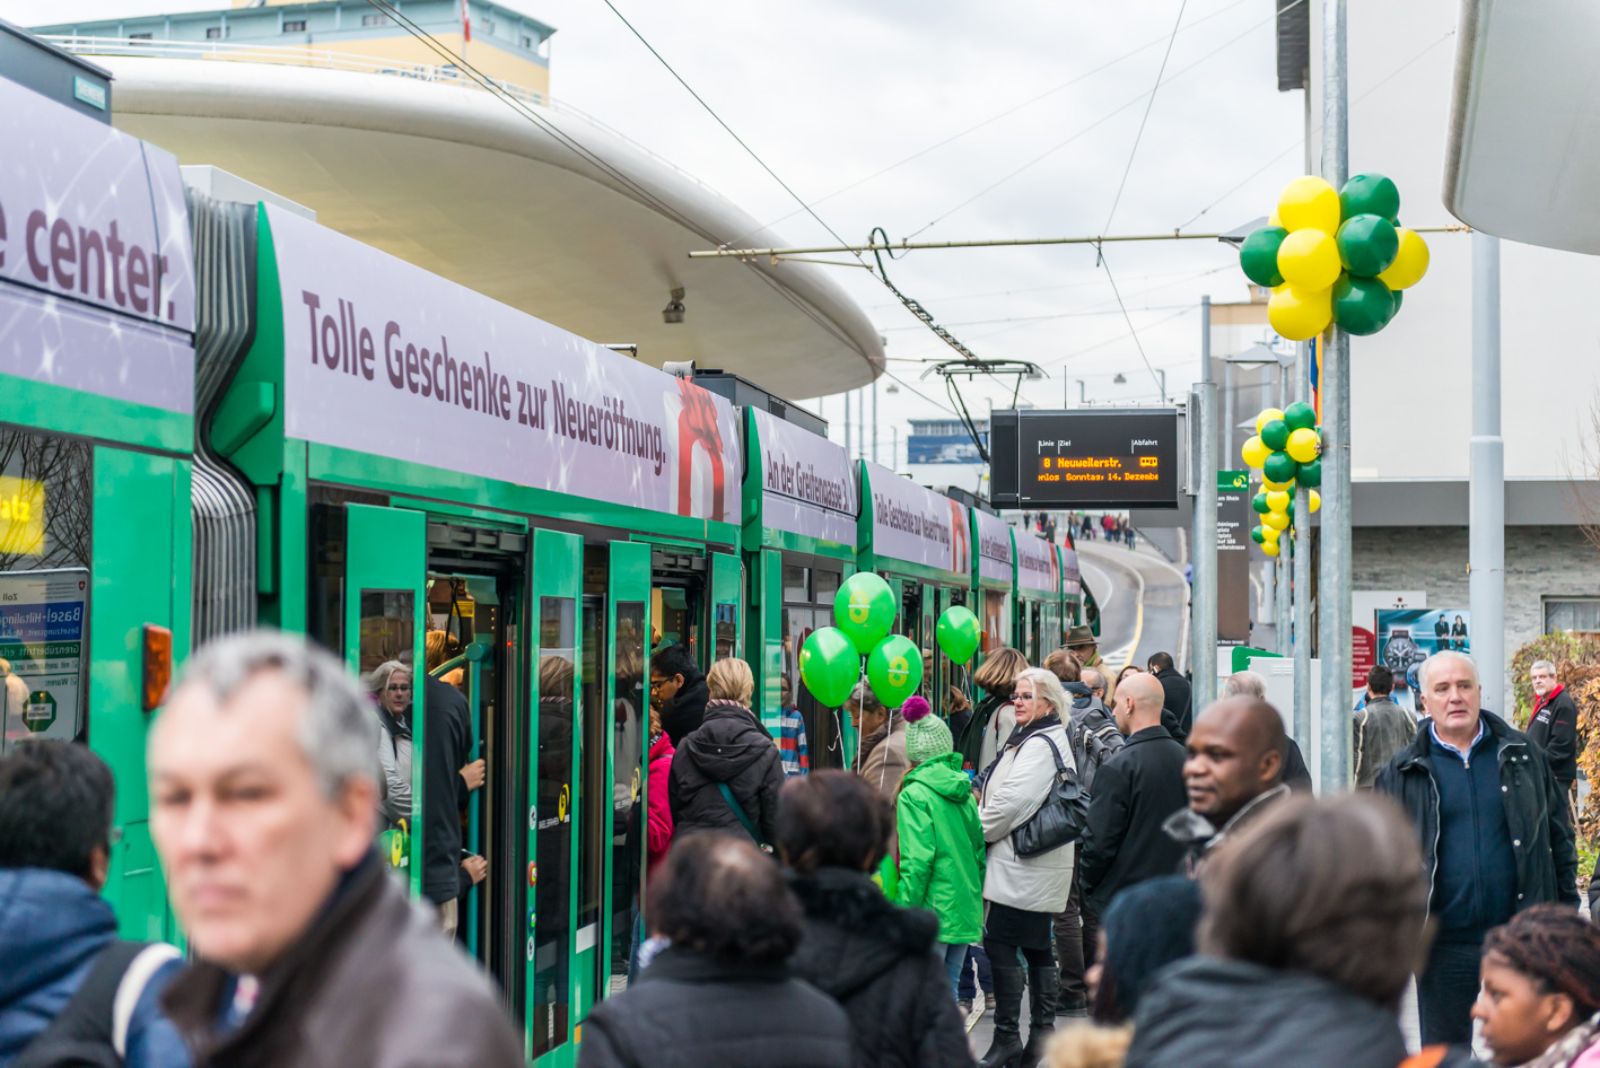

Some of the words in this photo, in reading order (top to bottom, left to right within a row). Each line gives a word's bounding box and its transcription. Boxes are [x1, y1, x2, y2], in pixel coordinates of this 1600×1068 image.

[26, 208, 175, 321] center.
[302, 289, 375, 381] Tolle
[384, 320, 511, 421] Geschenke
[516, 380, 548, 430] zur
[551, 379, 666, 476] Neueröffnung.
[767, 450, 780, 490] An
[781, 452, 795, 495] der
[1043, 457, 1051, 469] 8
[1057, 457, 1122, 468] Neuweilerstr.
[1108, 473, 1122, 481] 14.
